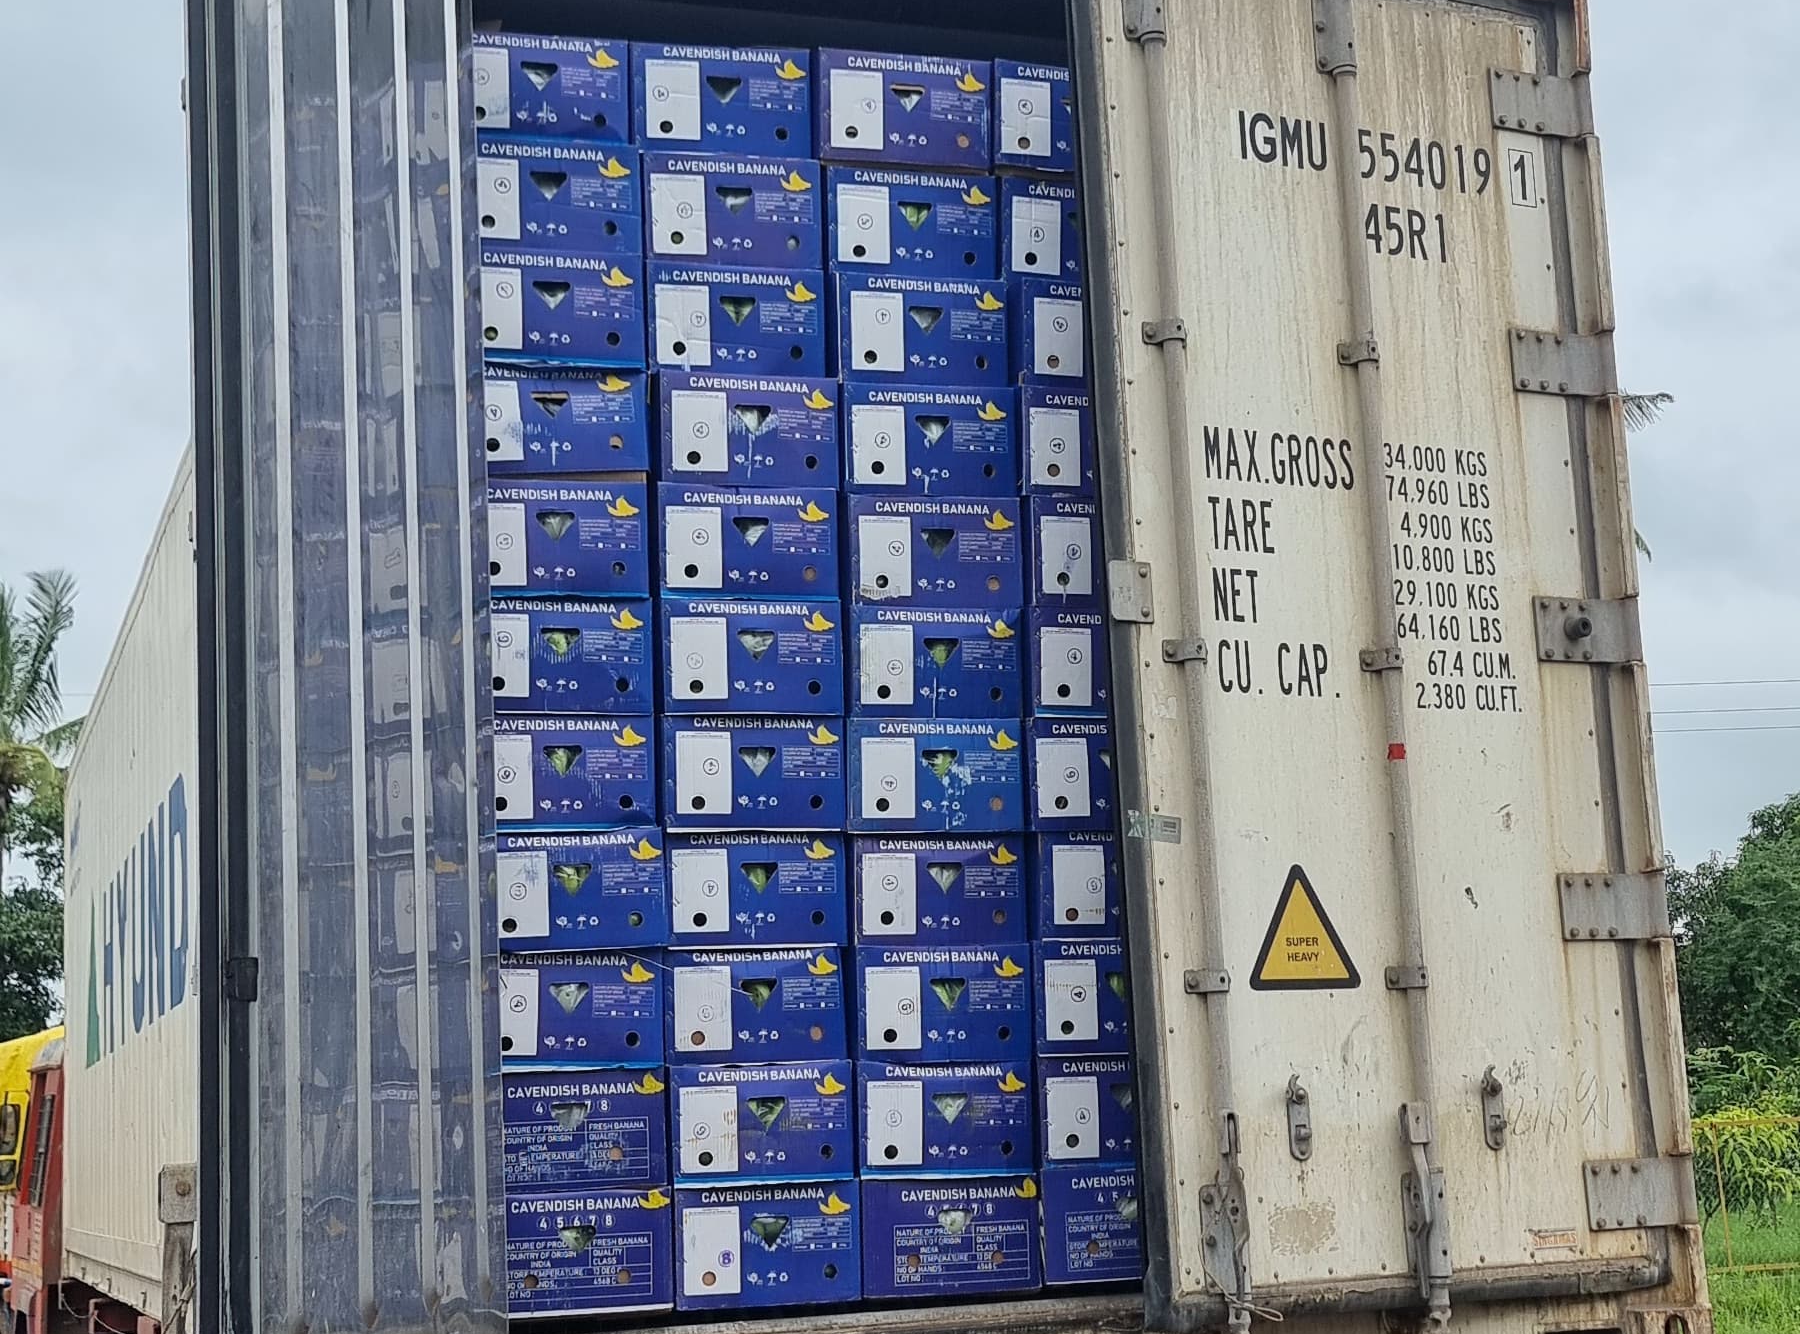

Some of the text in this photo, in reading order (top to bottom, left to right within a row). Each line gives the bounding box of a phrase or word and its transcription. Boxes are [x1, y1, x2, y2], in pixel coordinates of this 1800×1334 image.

[473, 34, 592, 53] CAVENDISH BANANA
[663, 47, 781, 63] CAVENDISH BANANA
[848, 57, 961, 76] CAVENDISH BANANA
[1018, 67, 1069, 81] CAVENDIS
[482, 143, 604, 162] CAVENDISH BANANA
[1239, 110, 1527, 200] IGMU 554019 1
[668, 160, 786, 176] CAVENDISH BANANA
[854, 171, 967, 189] CAVENDISH BANANA
[1029, 185, 1075, 199] CAVENDI
[1366, 203, 1446, 263] 45R1
[484, 253, 607, 270] CAVENDISH BANANA
[673, 271, 791, 286] CAVENDISH BANANA
[868, 278, 980, 295] CAVENDISH BANANA
[690, 376, 809, 393] CAVENDISH BANANA
[869, 391, 983, 405] CAVENDISH BANANA
[1046, 395, 1088, 406] CAVEND
[1204, 426, 1487, 490] MAX.GROSS 34,000 KGS
[487, 488, 612, 502] CAVENDISH BANANA
[1385, 475, 1489, 508] 74,960 LBS
[684, 492, 803, 506] CAVENDISH BANANA
[876, 502, 989, 514] CAVENDISH BANANA
[1208, 496, 1492, 554] TARE 4,900 KGS
[1393, 544, 1495, 575] 10,800 LBS
[1213, 567, 1499, 623] NET 29,100 KGS
[491, 599, 616, 613] CAVENDISH BANANA
[689, 603, 809, 615] CAVENDISH BANANA
[877, 611, 991, 624] CAVENDISH BANANA
[1058, 613, 1101, 625] CAVEND
[1398, 613, 1501, 643] 64,160 LBS
[1428, 650, 1463, 677] 67.4
[1416, 683, 1465, 709] 2,380
[493, 720, 619, 731] CAVENDISH BANANA
[694, 718, 814, 729] CAVENDISH BANANA
[879, 723, 993, 734] CAVENDISH BANANA
[1052, 724, 1107, 734] CAVENDIS
[508, 834, 635, 848] CAVENDISH BANANA
[690, 834, 809, 844] CAVENDISH BANANA
[1069, 831, 1112, 841] CAVEND
[880, 839, 994, 850] CAVENDISH BANANA
[104, 773, 188, 1055] HYUND
[1286, 937, 1318, 946] SUPER
[500, 954, 627, 966] CAVENDISH BANANA
[693, 949, 812, 962] CAVENDISH BANANA
[884, 951, 999, 962] CAVENDISH BANANA
[1288, 952, 1320, 961] HEAVY
[886, 1065, 1002, 1078] CAVENDISH BANANA
[1063, 1061, 1125, 1073] CAVENDISH
[698, 1068, 820, 1082] CAVENDISH BANANA
[507, 1082, 634, 1098] CAVENDISH BANANA
[536, 1103, 543, 1113] 4
[601, 1100, 608, 1110] 8
[589, 1123, 612, 1131] FRESH
[1072, 1175, 1134, 1189] CAVENDISH
[702, 1187, 824, 1203] CAVENDISH BANANA
[901, 1186, 1015, 1202] CAVENDISH BANANA
[1098, 1193, 1103, 1202] 4
[511, 1196, 640, 1213] CAVENDISH BANANA
[928, 1206, 934, 1215] 4
[986, 1204, 992, 1213] 8
[540, 1215, 612, 1228] 4 5 6 7 8
[897, 1228, 923, 1236] NATURE
[536, 1241, 545, 1249] OF
[897, 1275, 909, 1283] LOT
